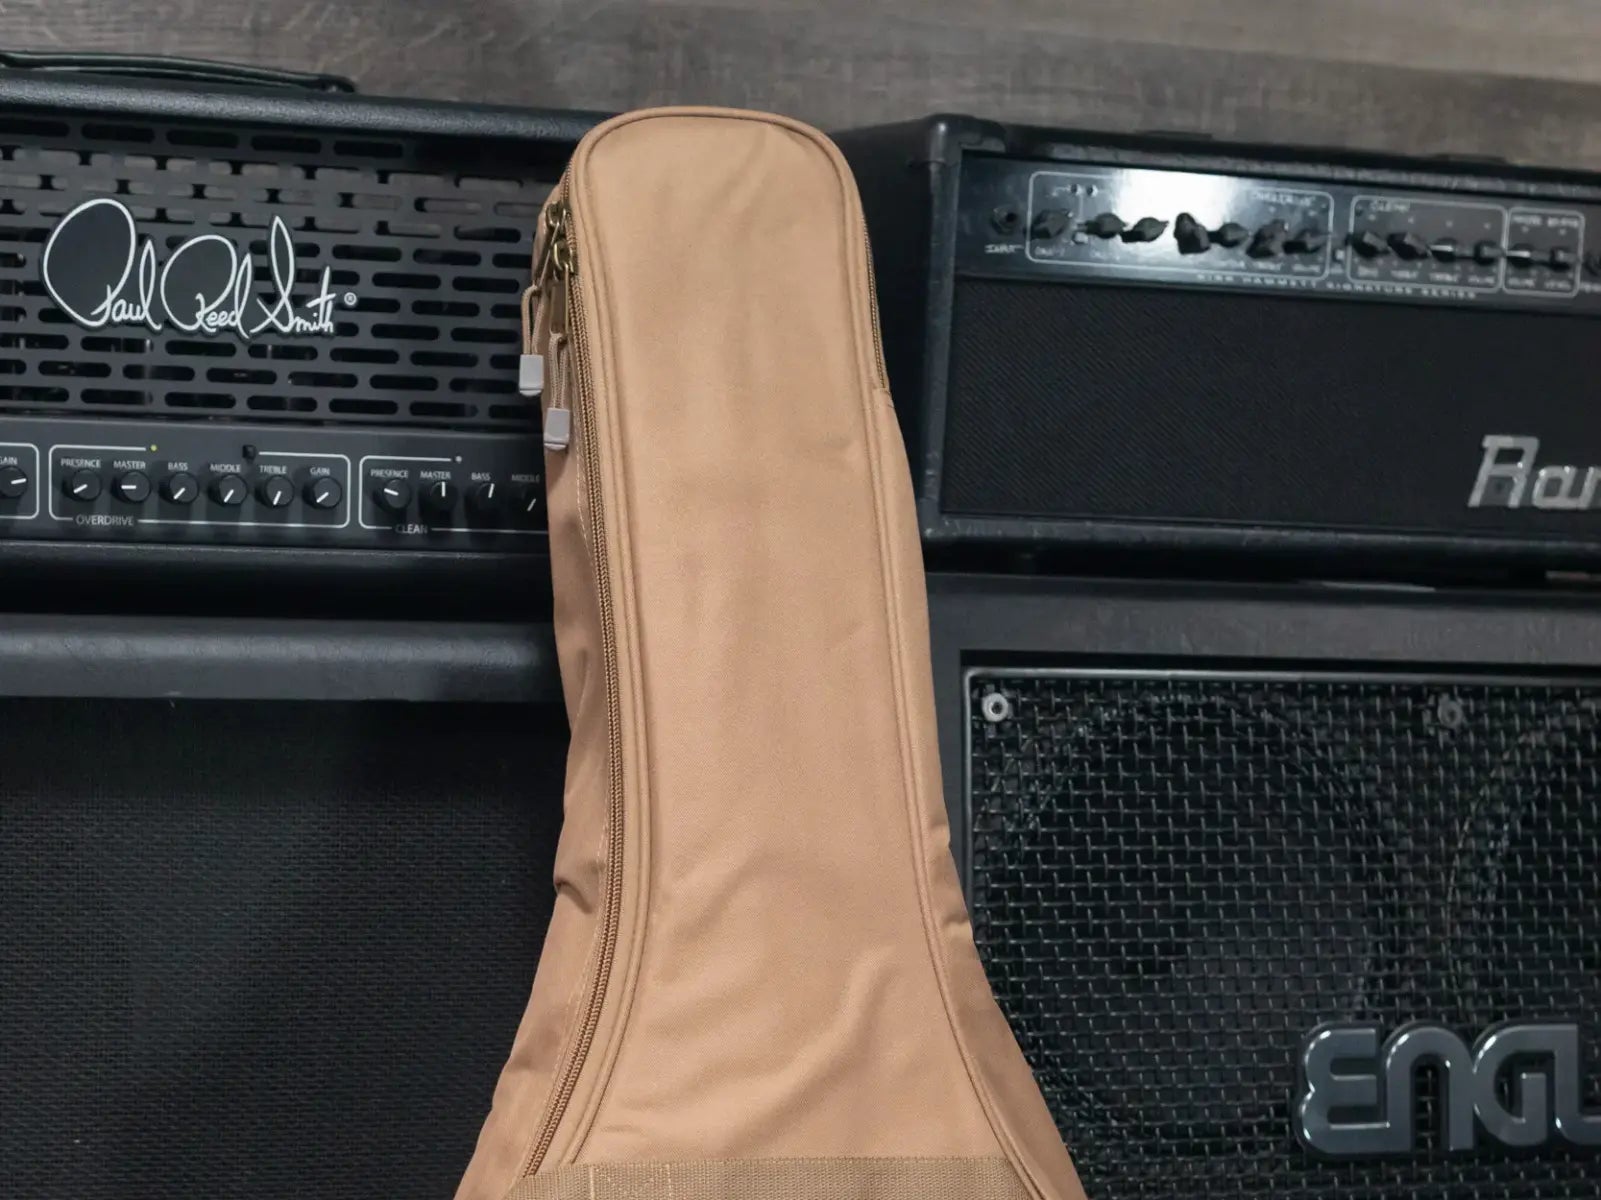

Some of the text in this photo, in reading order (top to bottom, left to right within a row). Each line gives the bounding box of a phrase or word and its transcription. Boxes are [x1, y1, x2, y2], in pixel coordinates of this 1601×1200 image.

[44, 199, 162, 331] Paul
[160, 234, 251, 339] Reed
[60, 458, 101, 469] PRESENCE
[113, 460, 146, 470] MASTER
[168, 462, 189, 471] BASS
[210, 463, 241, 473] MIDDLE
[259, 465, 287, 475] TREBLE
[310, 467, 330, 476] GAIN
[370, 469, 409, 479] PRESENCE
[420, 470, 451, 480] MASTER
[471, 472, 491, 482] BASS
[76, 515, 135, 526] OVERDRIVE
[395, 523, 429, 535] CLEAN
